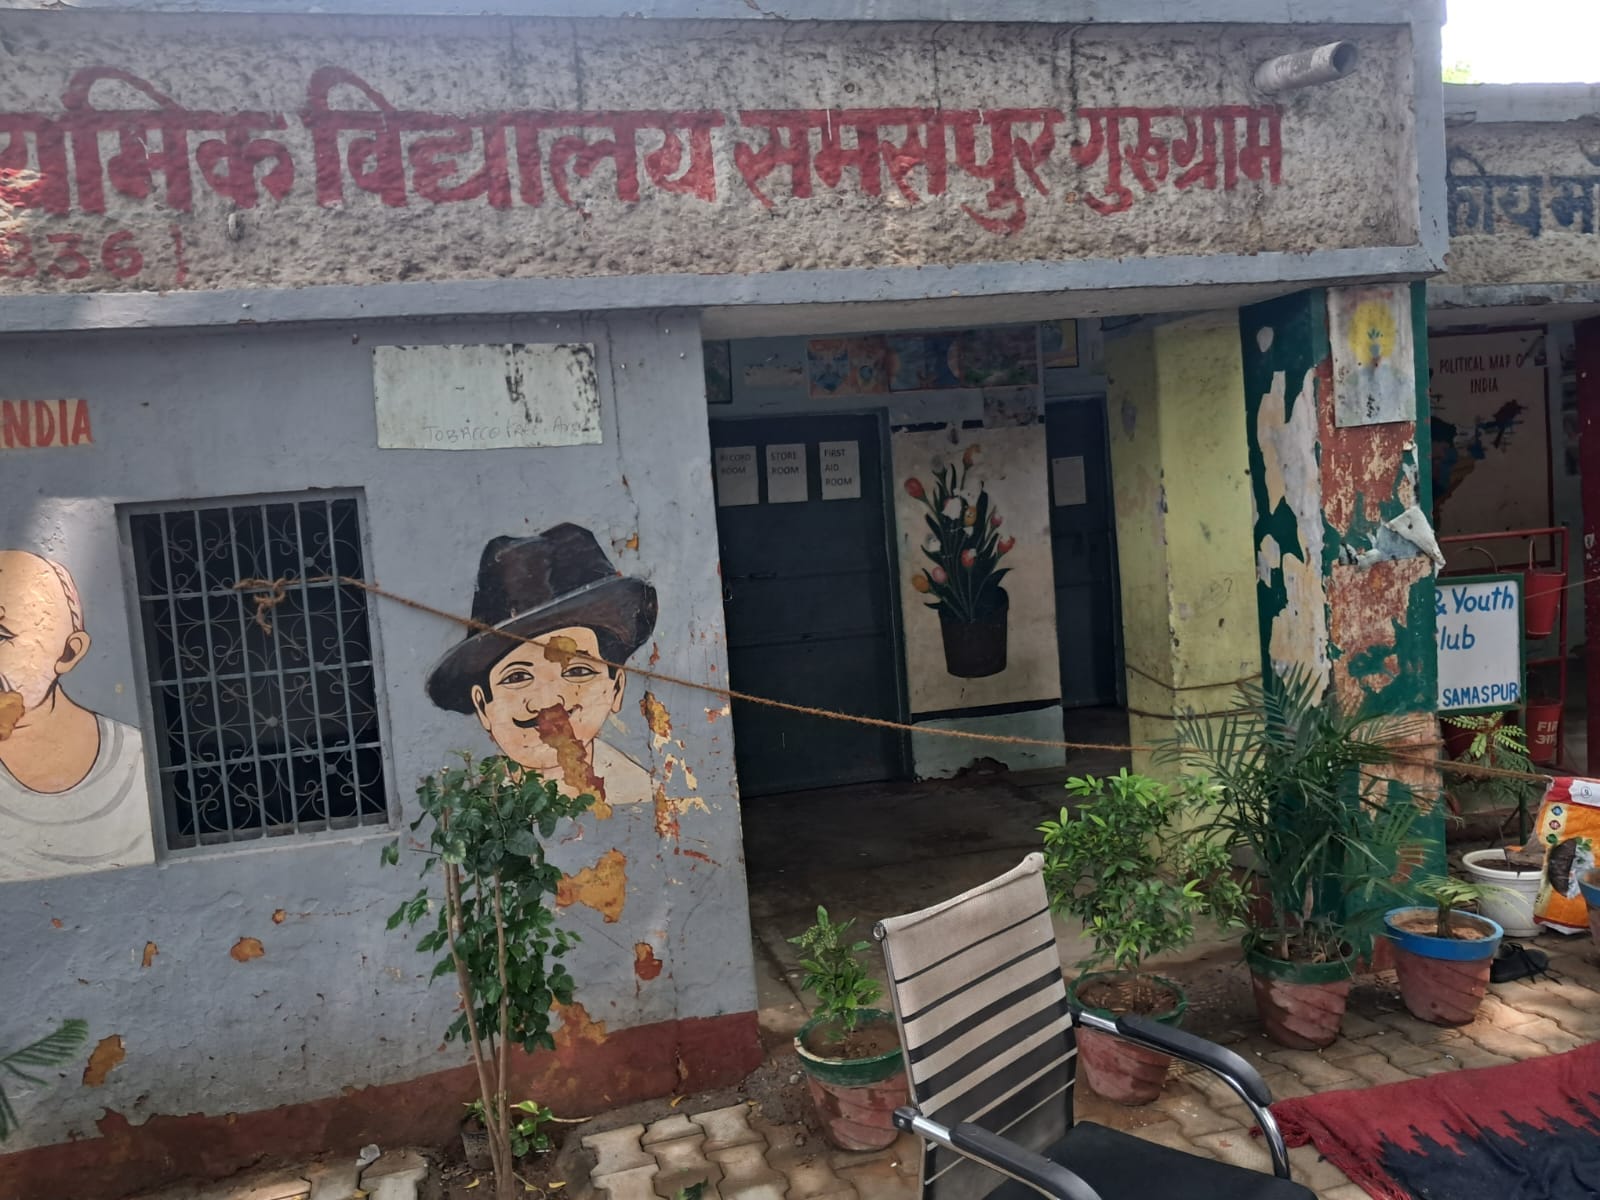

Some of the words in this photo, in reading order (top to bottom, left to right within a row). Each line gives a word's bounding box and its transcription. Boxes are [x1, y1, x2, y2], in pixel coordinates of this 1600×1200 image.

[301, 65, 725, 209] विद्यालय
[734, 106, 1064, 235] समसपुर
[1439, 355, 1485, 374] POLITICAL
[1489, 354, 1510, 369] MAP
[1470, 377, 1498, 394] INDIA
[720, 452, 751, 462] RECORD
[770, 451, 797, 461] STORE
[824, 448, 846, 457] FIRST
[720, 466, 746, 475] ROOM
[771, 466, 799, 475] ROOM
[824, 463, 839, 472] AID
[825, 477, 852, 486] ROOM
[1451, 585, 1514, 614] Youth
[1442, 682, 1519, 707] SAMASPUR
